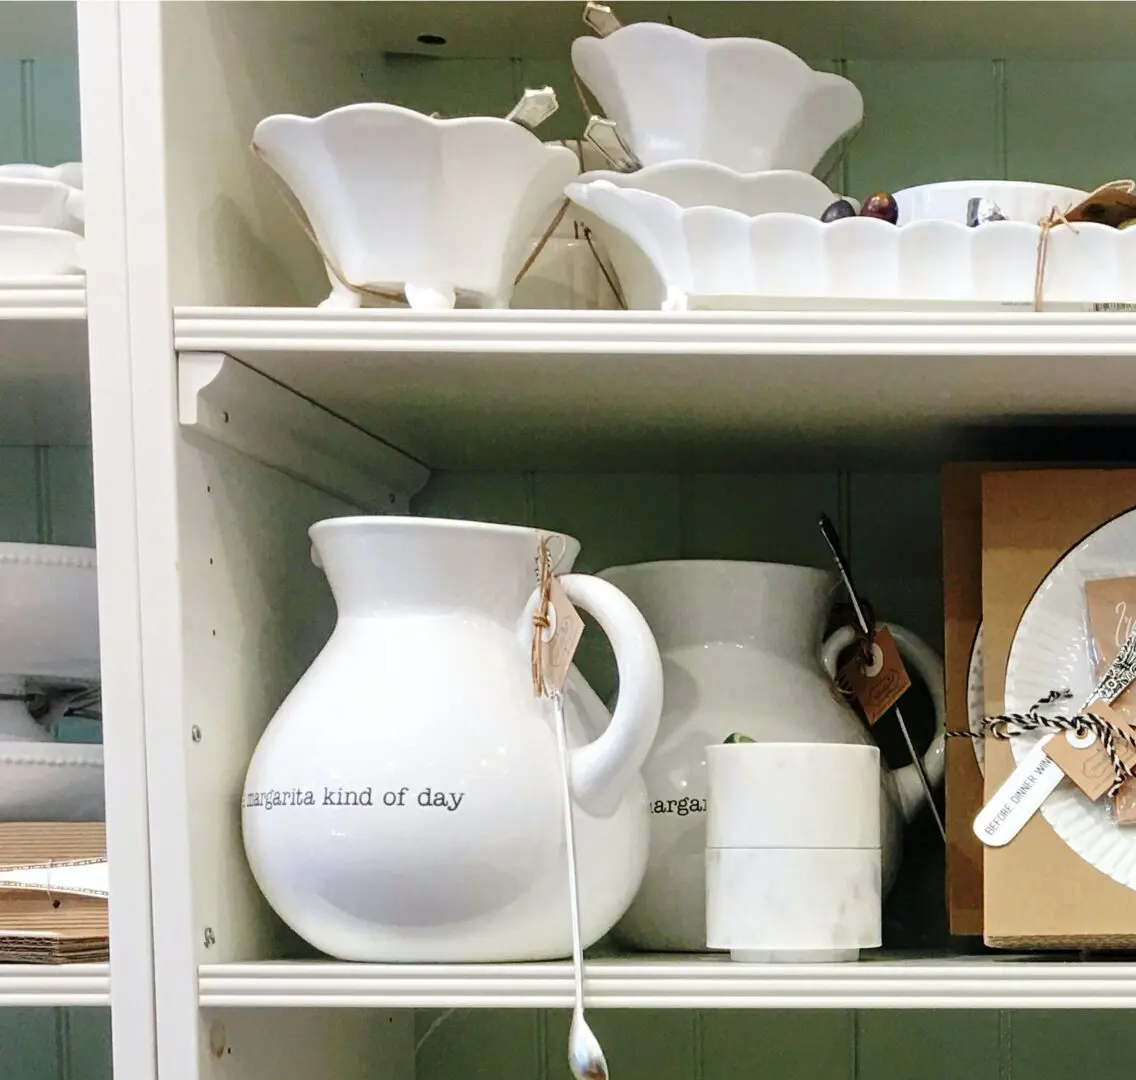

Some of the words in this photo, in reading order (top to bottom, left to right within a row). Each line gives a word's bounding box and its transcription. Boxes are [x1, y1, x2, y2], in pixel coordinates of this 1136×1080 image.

[322, 786, 373, 807] kind
[383, 787, 410, 807] of
[416, 787, 466, 812] day
[984, 803, 1014, 837] BEFORE
[1009, 775, 1039, 806] DINNER
